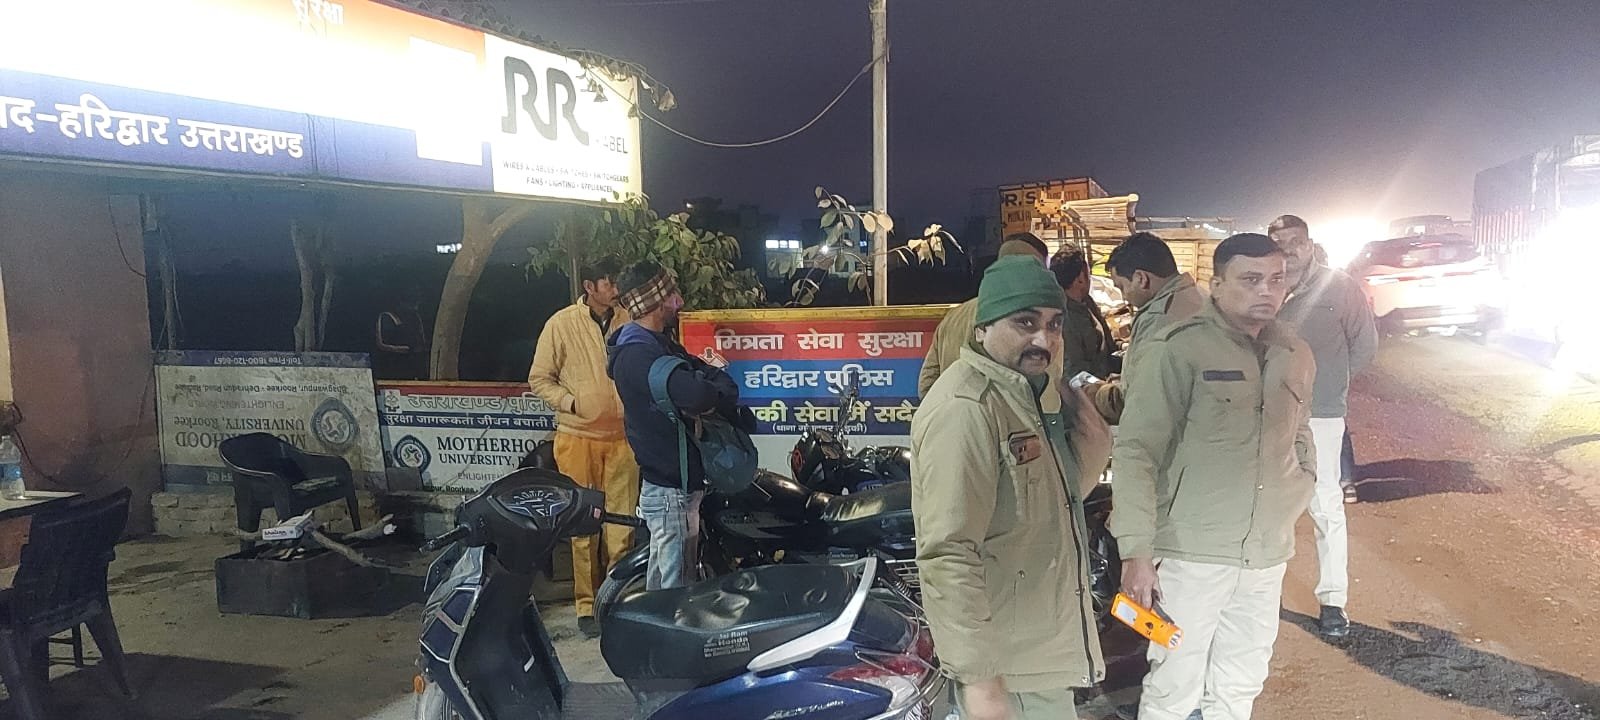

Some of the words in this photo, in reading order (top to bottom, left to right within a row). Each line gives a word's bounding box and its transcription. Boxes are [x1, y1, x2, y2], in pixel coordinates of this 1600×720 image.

[501, 56, 590, 147] RR
[177, 118, 304, 158] उत्तराखण्ड
[502, 160, 524, 171] WIRES
[526, 176, 543, 186] FANS
[714, 328, 785, 350] मित्रता
[797, 328, 844, 350] सेवा
[858, 331, 924, 356] सुरक्षा
[744, 363, 820, 388] हरिद्वार
[824, 363, 895, 394] पुलिस
[222, 384, 260, 393] Dehradun
[267, 384, 297, 393] Roorkee
[407, 393, 503, 411] उत्तराखण्ड
[794, 400, 841, 422] सेवा
[847, 401, 871, 422] में
[174, 416, 219, 426] Roorkee
[223, 418, 305, 431] UNIVERSITY,
[384, 414, 413, 426] सुरक्षा
[417, 413, 474, 426] जागरूकता
[477, 415, 510, 428] जीवन
[513, 416, 548, 428] बचाती
[439, 453, 515, 467] UNIVERSITY,
